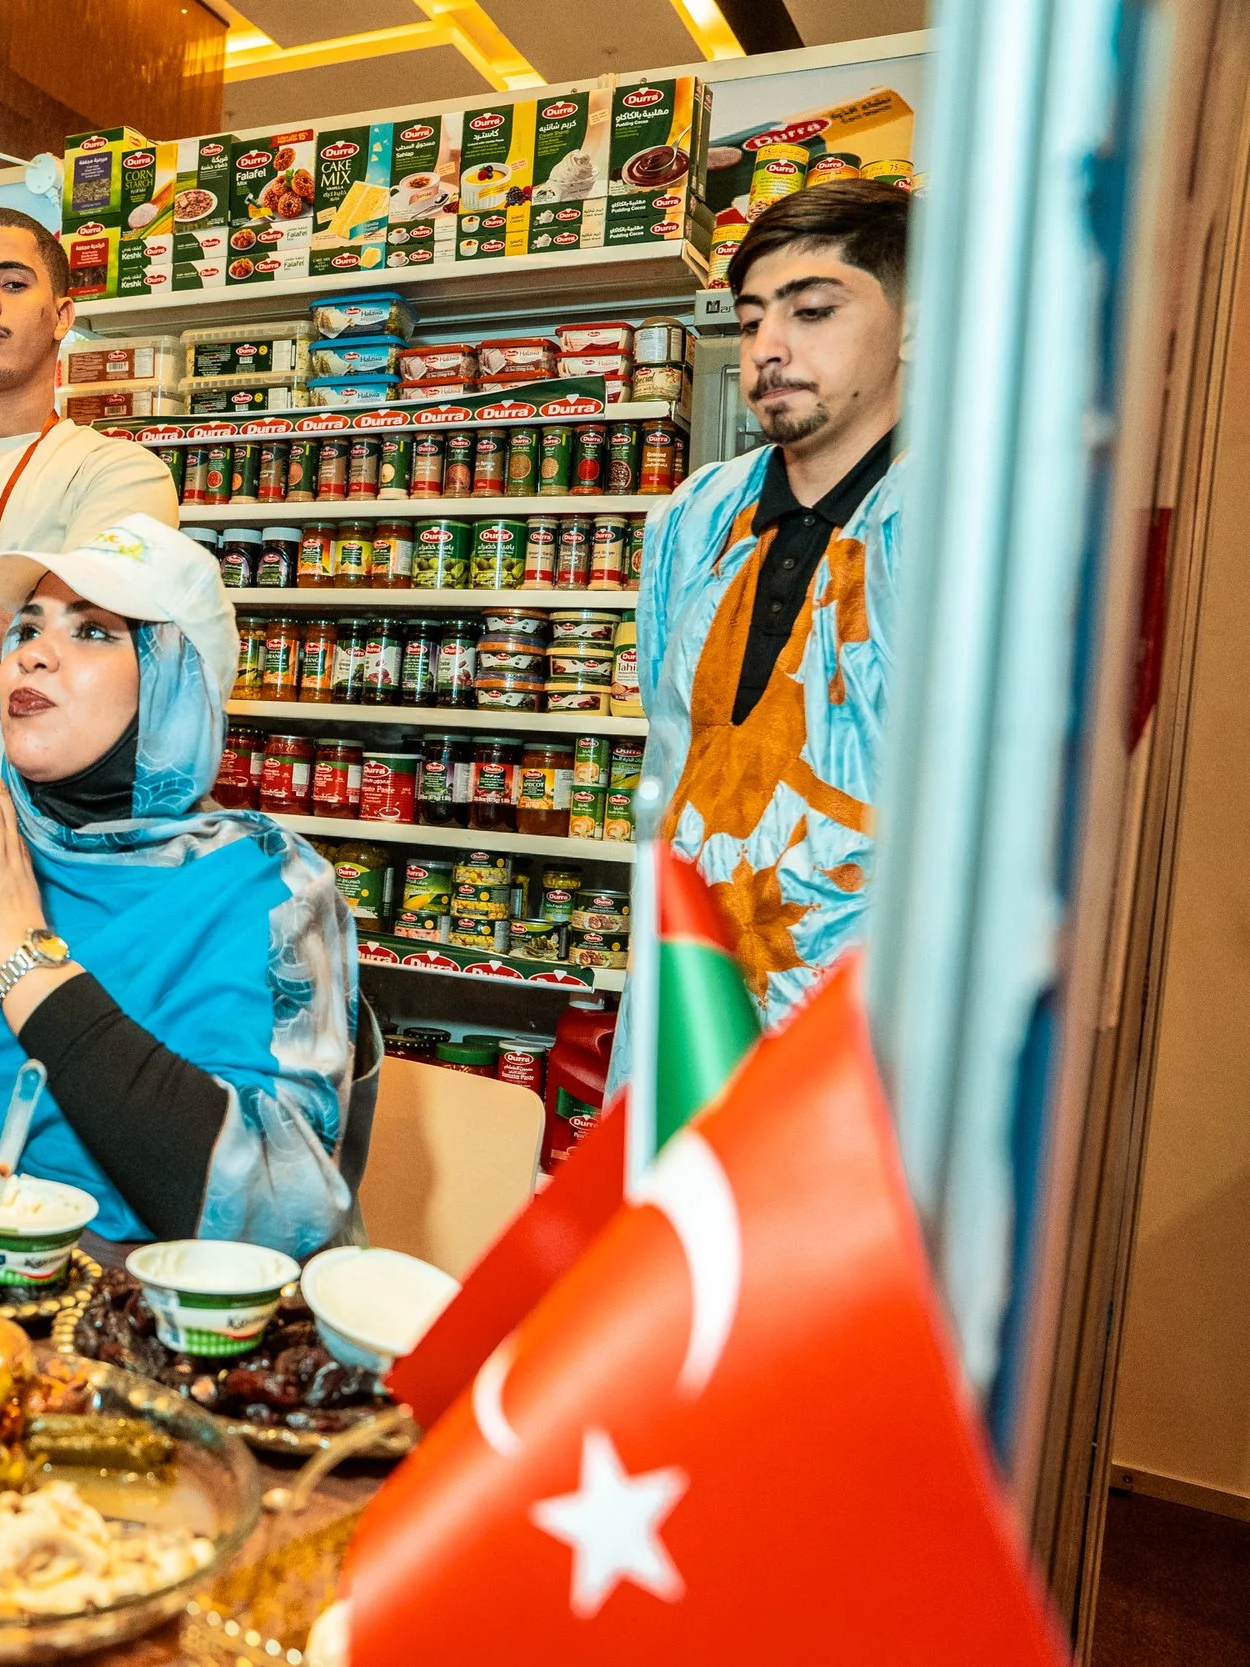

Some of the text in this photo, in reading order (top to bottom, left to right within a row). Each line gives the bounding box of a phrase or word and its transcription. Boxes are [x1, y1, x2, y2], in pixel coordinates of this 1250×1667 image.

[628, 94, 659, 104] Durra
[547, 106, 574, 116] Durra
[475, 118, 501, 127] Durra
[561, 120, 577, 129] كريم
[615, 120, 634, 128] Pudding
[405, 130, 430, 139] Durra
[473, 129, 500, 140] كاسترد
[754, 121, 821, 148] Durra
[83, 139, 106, 149] Durra
[202, 147, 221, 155] Durra
[325, 146, 356, 157] Durra
[127, 157, 151, 166] Durra
[240, 155, 268, 167] Durra
[819, 161, 842, 170] Durra
[321, 160, 352, 174] CAKE
[769, 164, 795, 173] Durra
[125, 169, 154, 182] CORN
[236, 168, 267, 182] Falafel
[320, 171, 351, 187] MIX
[125, 179, 154, 189] STARCH
[656, 199, 679, 207] Durra
[611, 206, 630, 214] Pudding
[558, 211, 579, 219] Durra
[484, 219, 505, 227] Durra
[79, 226, 103, 236] Durra
[287, 229, 308, 238] Falafel
[411, 229, 431, 237] Durra
[654, 225, 677, 233] Durra
[258, 232, 282, 241] Durra
[556, 235, 577, 243] Durra
[609, 231, 629, 239] Pudding
[146, 247, 166, 256] Durra
[718, 246, 737, 254] Durr
[121, 252, 142, 260] Keshk
[284, 259, 305, 268] Falafel
[335, 257, 357, 265] Durra
[257, 262, 279, 271] Durra
[121, 280, 142, 289] Keshk
[146, 276, 166, 285] Durra
[361, 308, 383, 317] Halawa
[360, 355, 383, 363] Halawa
[357, 391, 380, 399] Halawa
[483, 407, 528, 419] Durra
[548, 402, 595, 415] Durra
[360, 416, 403, 427] Durra
[421, 411, 464, 423] Durra
[247, 424, 286, 435] Durra
[303, 420, 343, 431] Durra
[142, 430, 177, 441] Durra
[193, 427, 231, 438] Durra
[424, 533, 449, 541] Durra
[484, 533, 510, 541] Durra
[618, 663, 638, 672] Tahi
[364, 766, 386, 775] Durra
[507, 1054, 530, 1063] Durra
